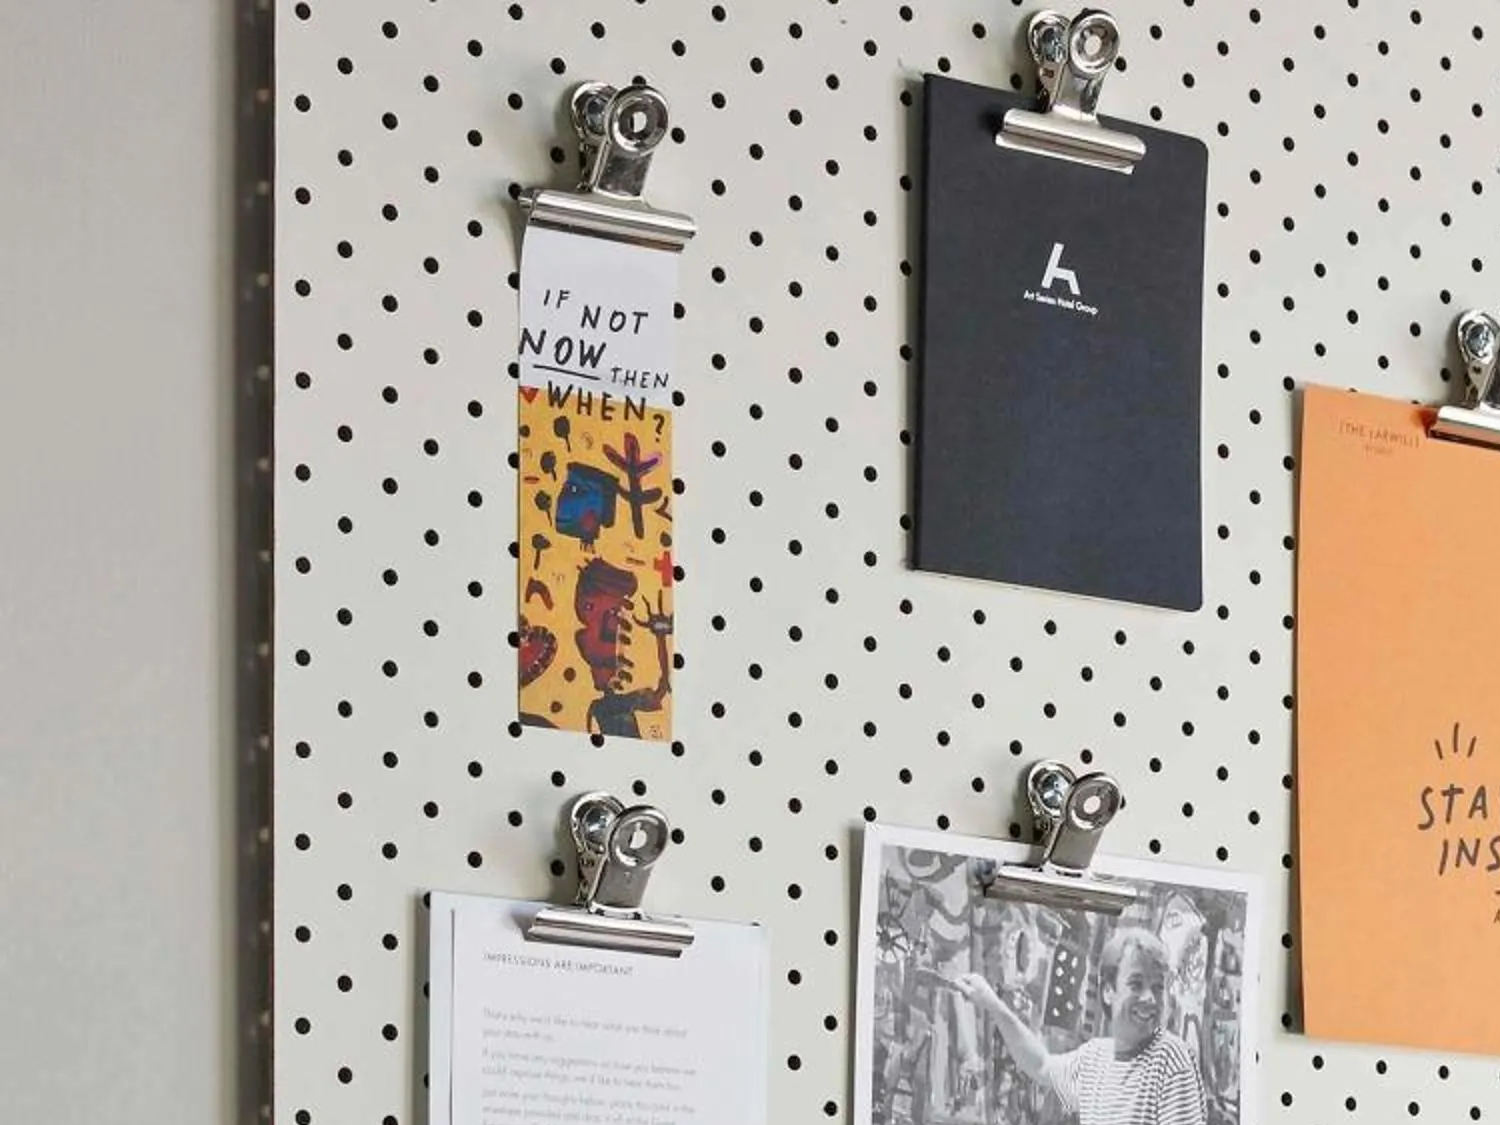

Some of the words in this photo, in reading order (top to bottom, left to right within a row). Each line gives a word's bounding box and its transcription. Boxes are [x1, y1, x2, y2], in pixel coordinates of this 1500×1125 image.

[543, 289, 571, 308] IF
[580, 305, 649, 334] NOT
[518, 327, 607, 369] NOW
[610, 367, 669, 388] THEN
[547, 380, 665, 442] WHEN?
